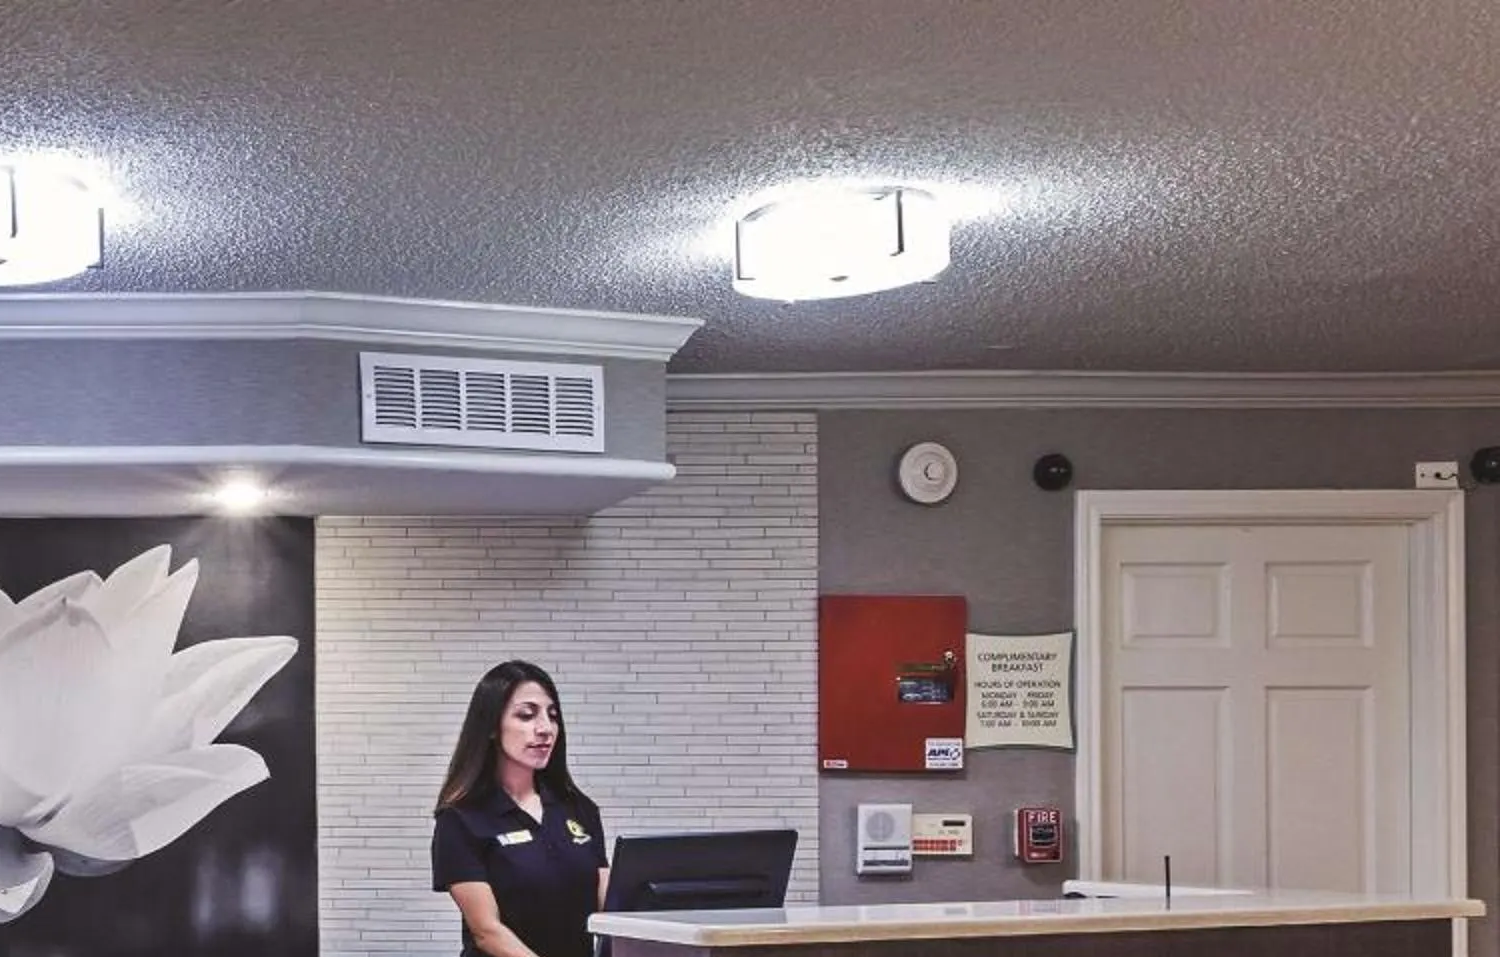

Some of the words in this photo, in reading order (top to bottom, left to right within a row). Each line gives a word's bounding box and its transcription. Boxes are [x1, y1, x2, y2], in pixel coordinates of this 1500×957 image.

[977, 652, 1058, 661] COMPLIMENTARY
[991, 663, 1043, 673] BREAKFAST
[974, 680, 1003, 689] HOURS
[1004, 680, 1014, 689] OF
[1015, 680, 1061, 689] OPERATION
[981, 691, 1017, 699] MONDAY
[1027, 691, 1055, 699] FRIDAY
[1000, 700, 1013, 708] AM
[1041, 700, 1055, 708] AM
[998, 719, 1012, 727] AM
[1028, 811, 1056, 823] FIRE
